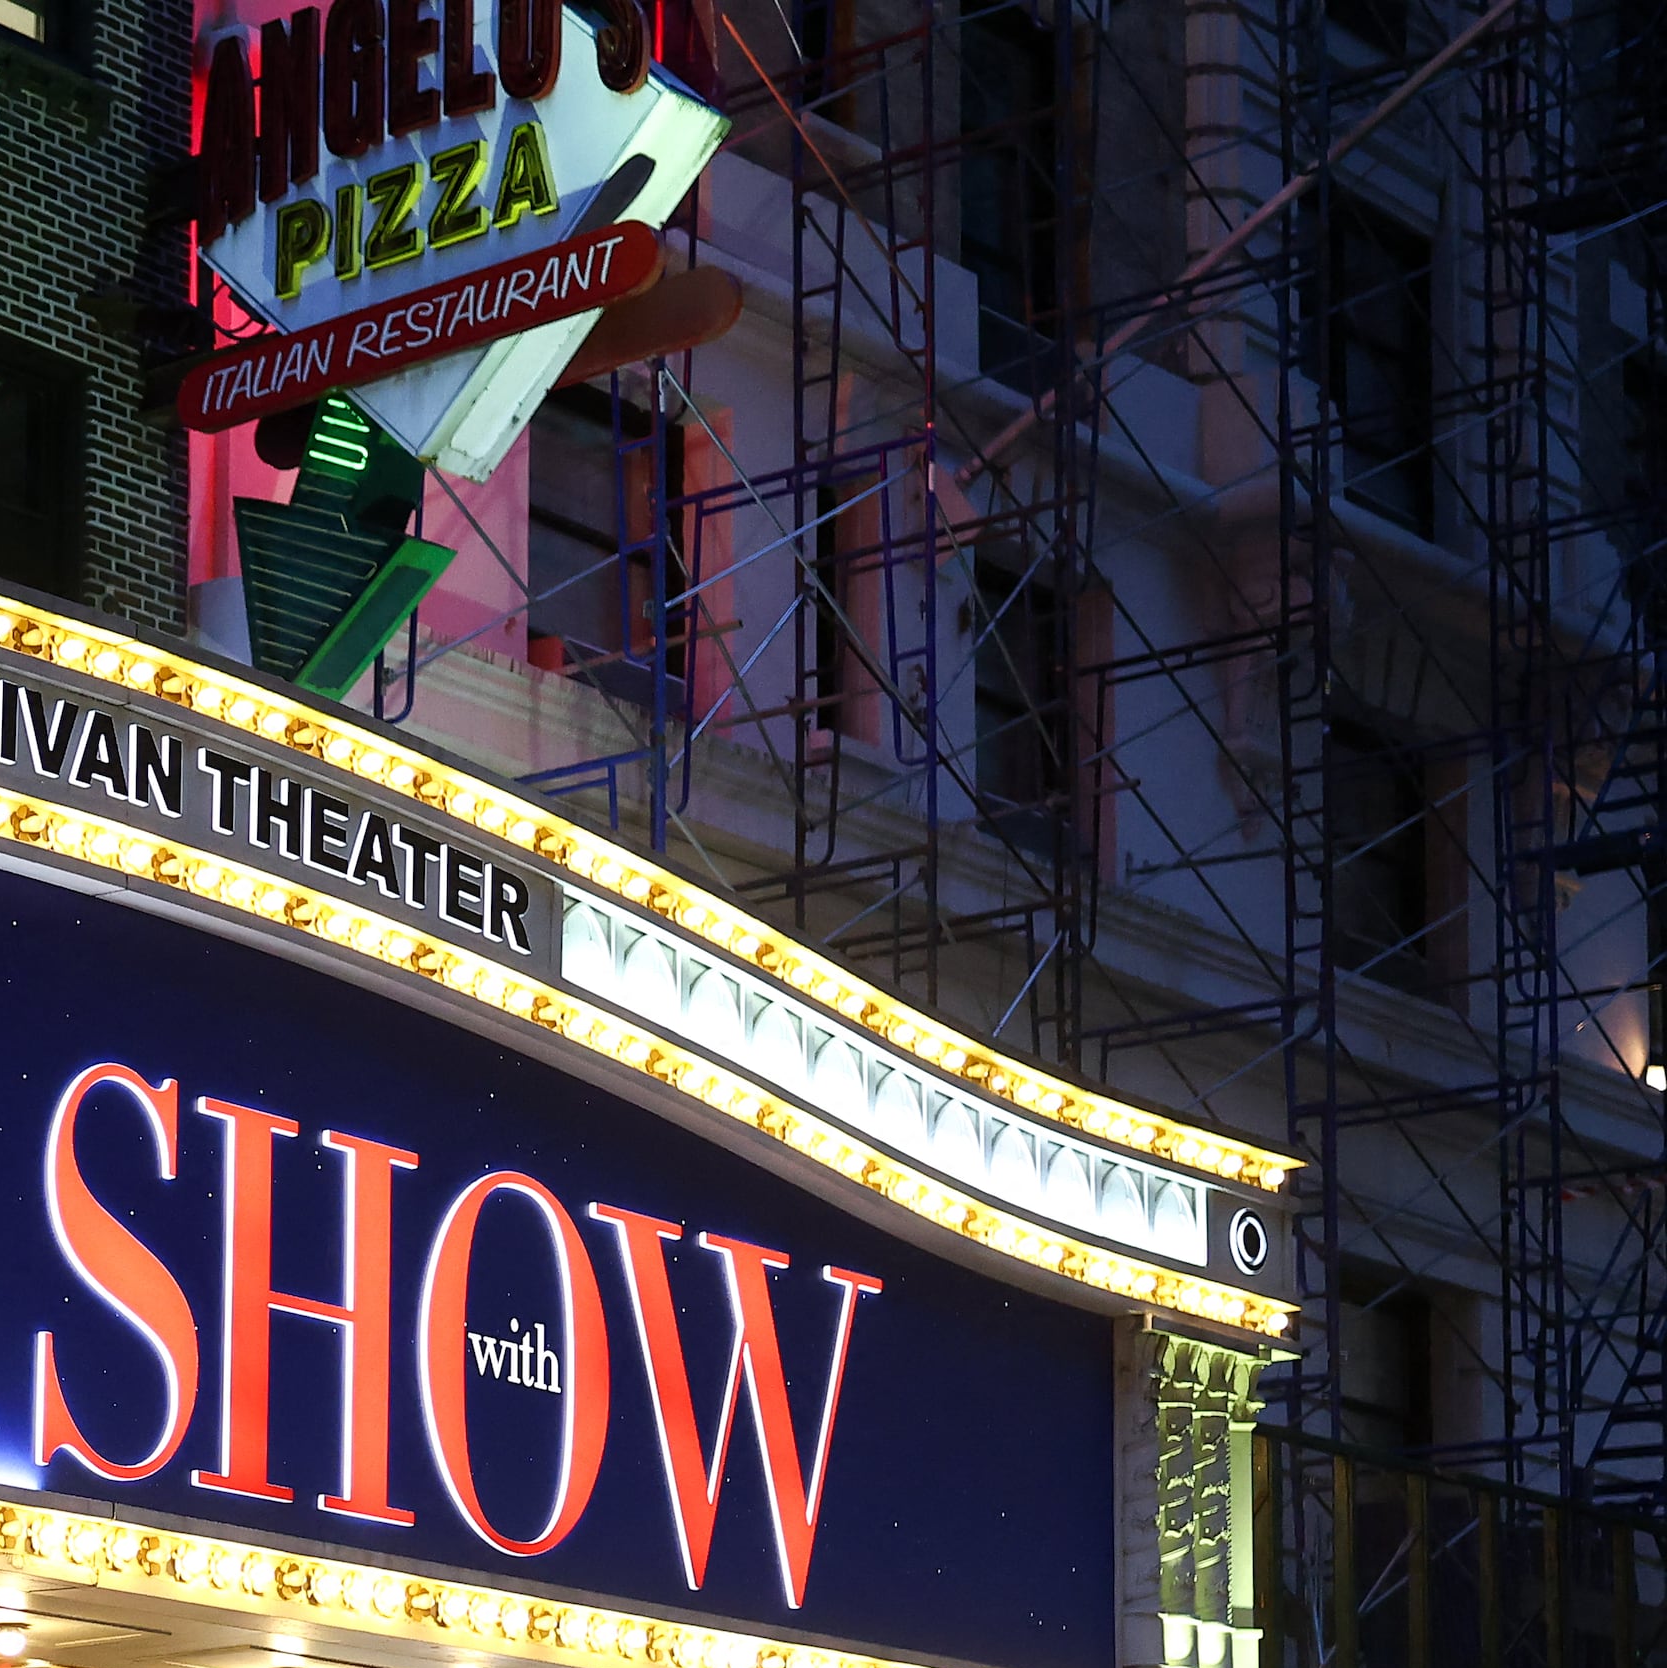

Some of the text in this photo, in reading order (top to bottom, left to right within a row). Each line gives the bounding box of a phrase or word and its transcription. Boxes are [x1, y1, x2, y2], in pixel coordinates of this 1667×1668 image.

[275, 121, 558, 299] PIZZA
[202, 236, 623, 413] ITALIAN RESTAURANT
[197, 747, 532, 956] THEATER
[31, 1063, 883, 1610] SHOW
[467, 1317, 562, 1394] with
